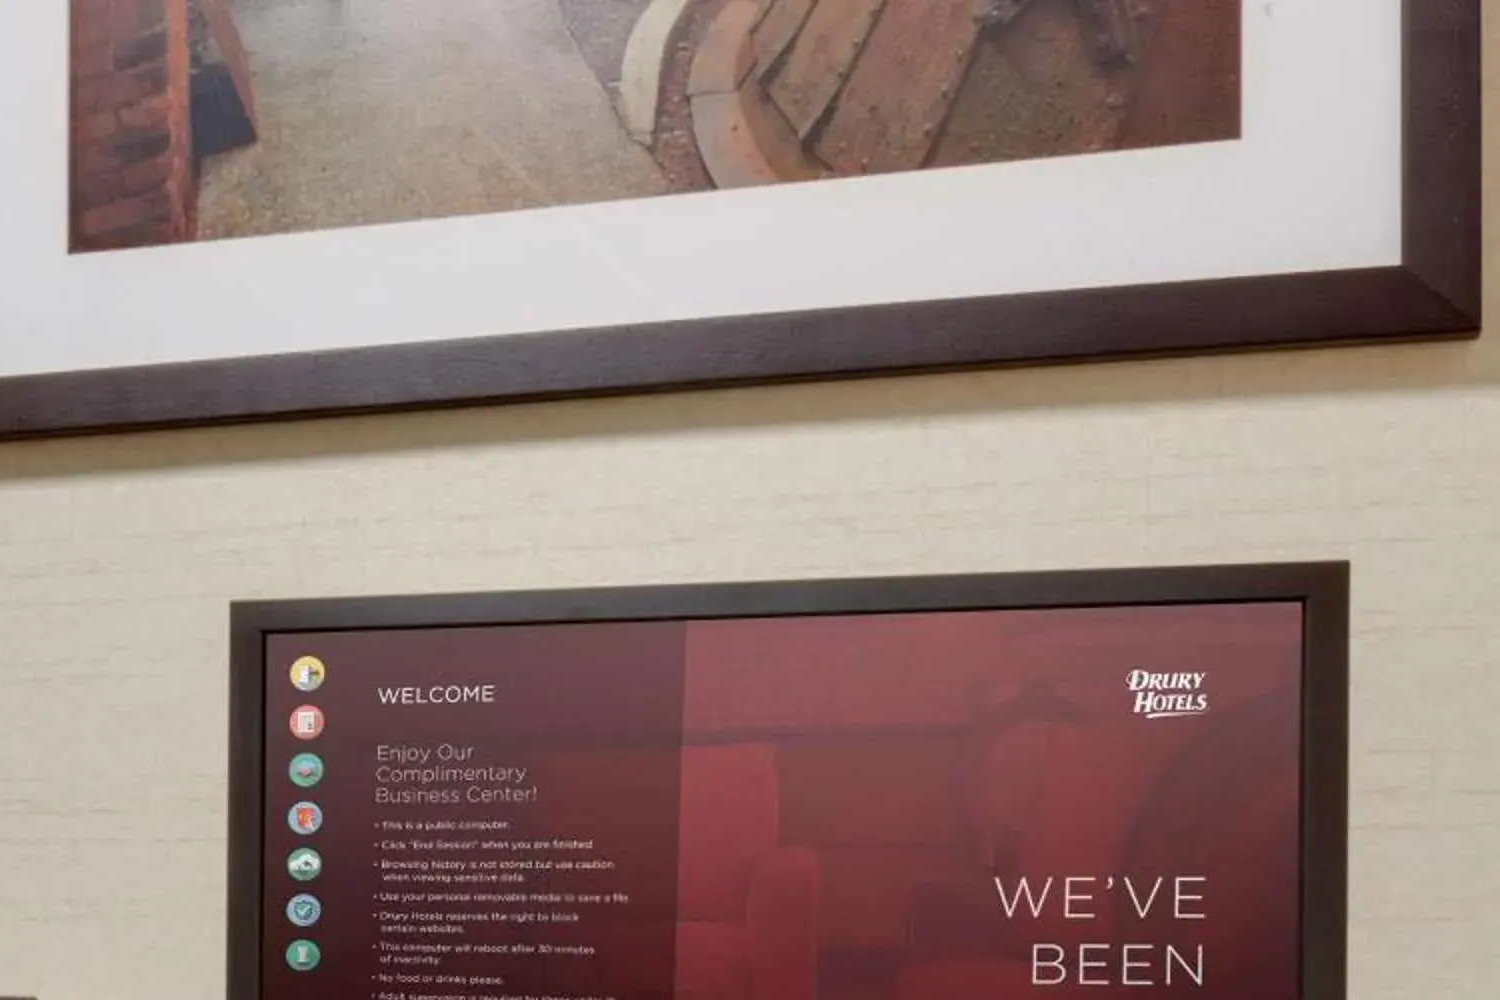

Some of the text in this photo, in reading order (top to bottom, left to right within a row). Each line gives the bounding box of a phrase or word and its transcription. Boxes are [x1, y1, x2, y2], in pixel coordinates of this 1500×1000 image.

[1126, 669, 1206, 691] DRURY
[377, 684, 496, 704] WELCOME
[1133, 691, 1208, 713] HOTELS
[377, 743, 475, 765] Enjoy Our
[376, 765, 528, 784] Complimentary
[375, 784, 538, 804] Business Center!
[425, 821, 456, 832] public
[511, 840, 532, 851] you
[994, 876, 1206, 919] WE'VE
[1032, 944, 1204, 986] BEEN
